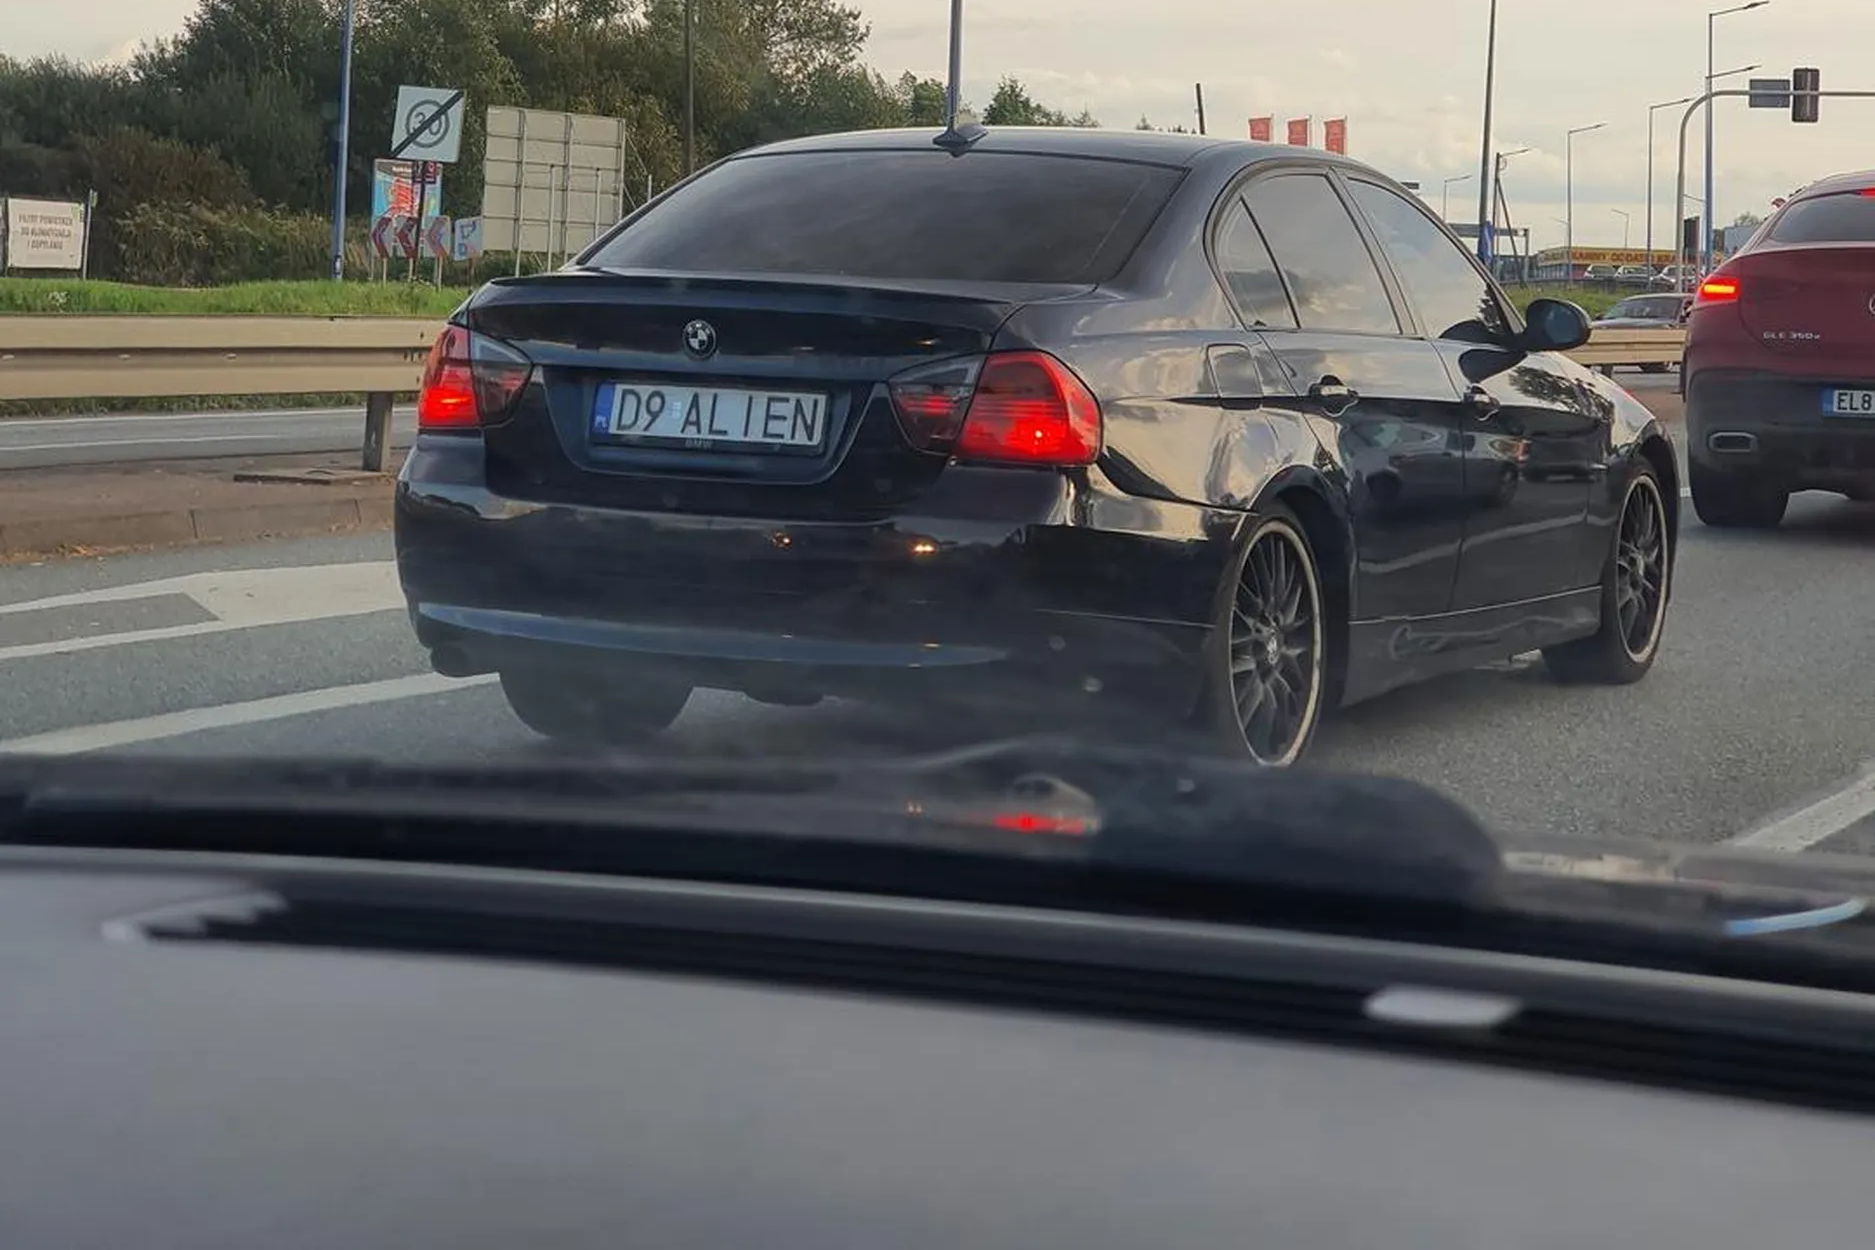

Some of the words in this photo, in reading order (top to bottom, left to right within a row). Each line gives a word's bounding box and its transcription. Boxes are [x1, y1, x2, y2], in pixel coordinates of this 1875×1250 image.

[1763, 331, 1786, 340] GLE
[1837, 392, 1872, 411] EL8
[616, 388, 666, 432] D9
[680, 391, 819, 442] ALIEN
